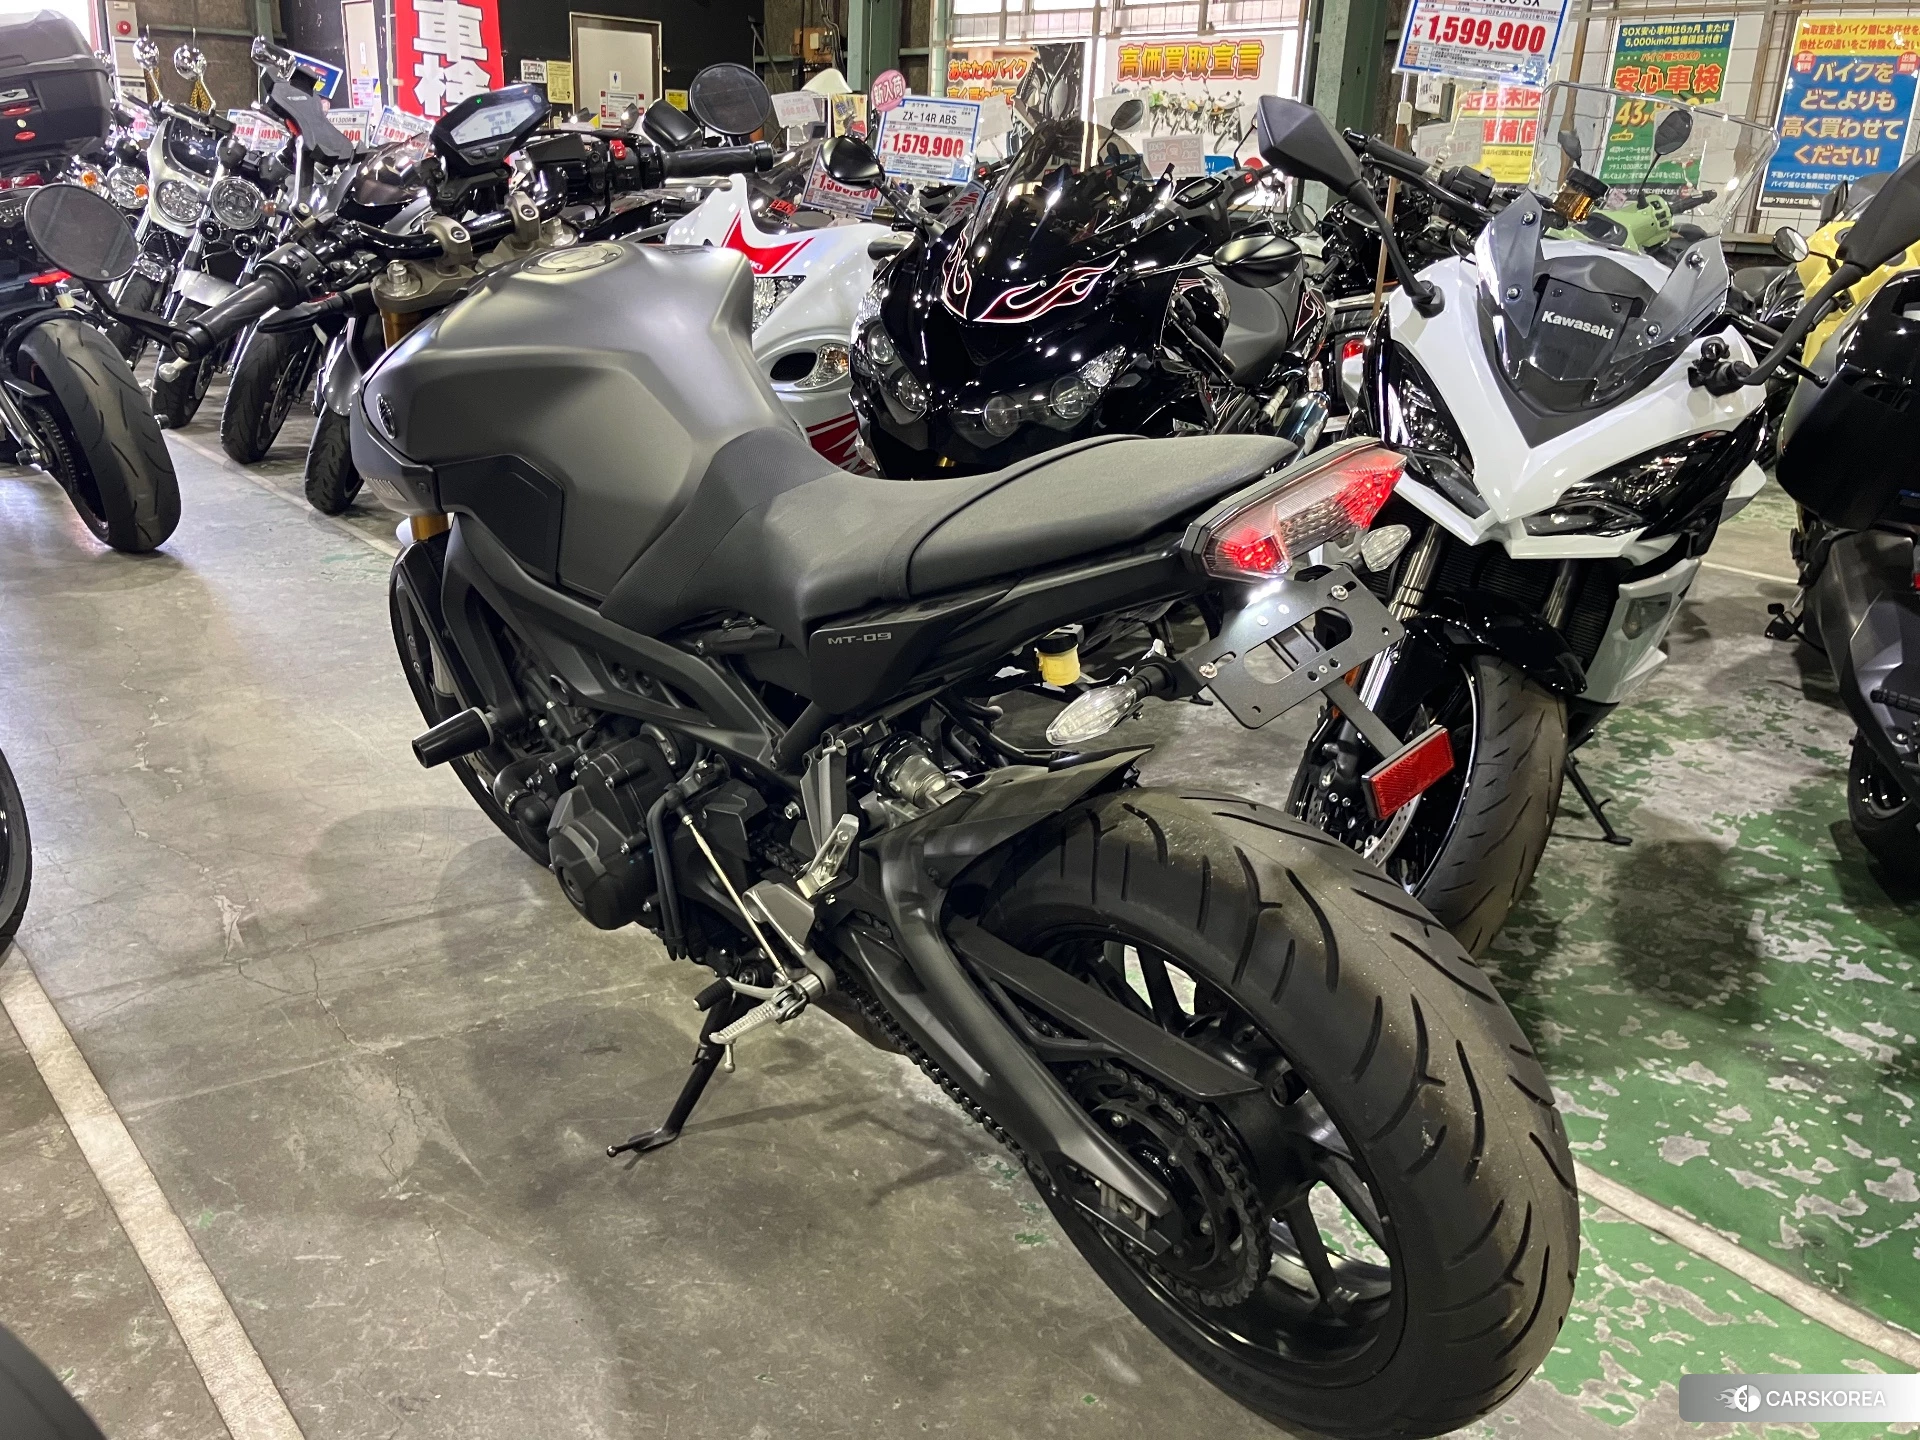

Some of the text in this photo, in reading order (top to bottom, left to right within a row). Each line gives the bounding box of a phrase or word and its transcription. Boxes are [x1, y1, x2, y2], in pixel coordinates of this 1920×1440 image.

[1428, 14, 1547, 54] 1,599,900
[412, 0, 491, 117] 車検
[948, 58, 1028, 81] あなたのバイク
[1118, 41, 1264, 80] 高価買取宣言
[1614, 63, 1723, 95] 安心車検
[1812, 61, 1894, 83] バイクを
[872, 74, 904, 105] 新入荷
[1800, 89, 1896, 111] どこよりも
[902, 111, 957, 125] ZX-14R ABS
[1780, 117, 1904, 140] 高く買わせて
[892, 133, 964, 159] 1,579,900
[1793, 144, 1881, 166] ください!
[1541, 310, 1615, 340] Kawasaki
[827, 632, 892, 645] MT-09
